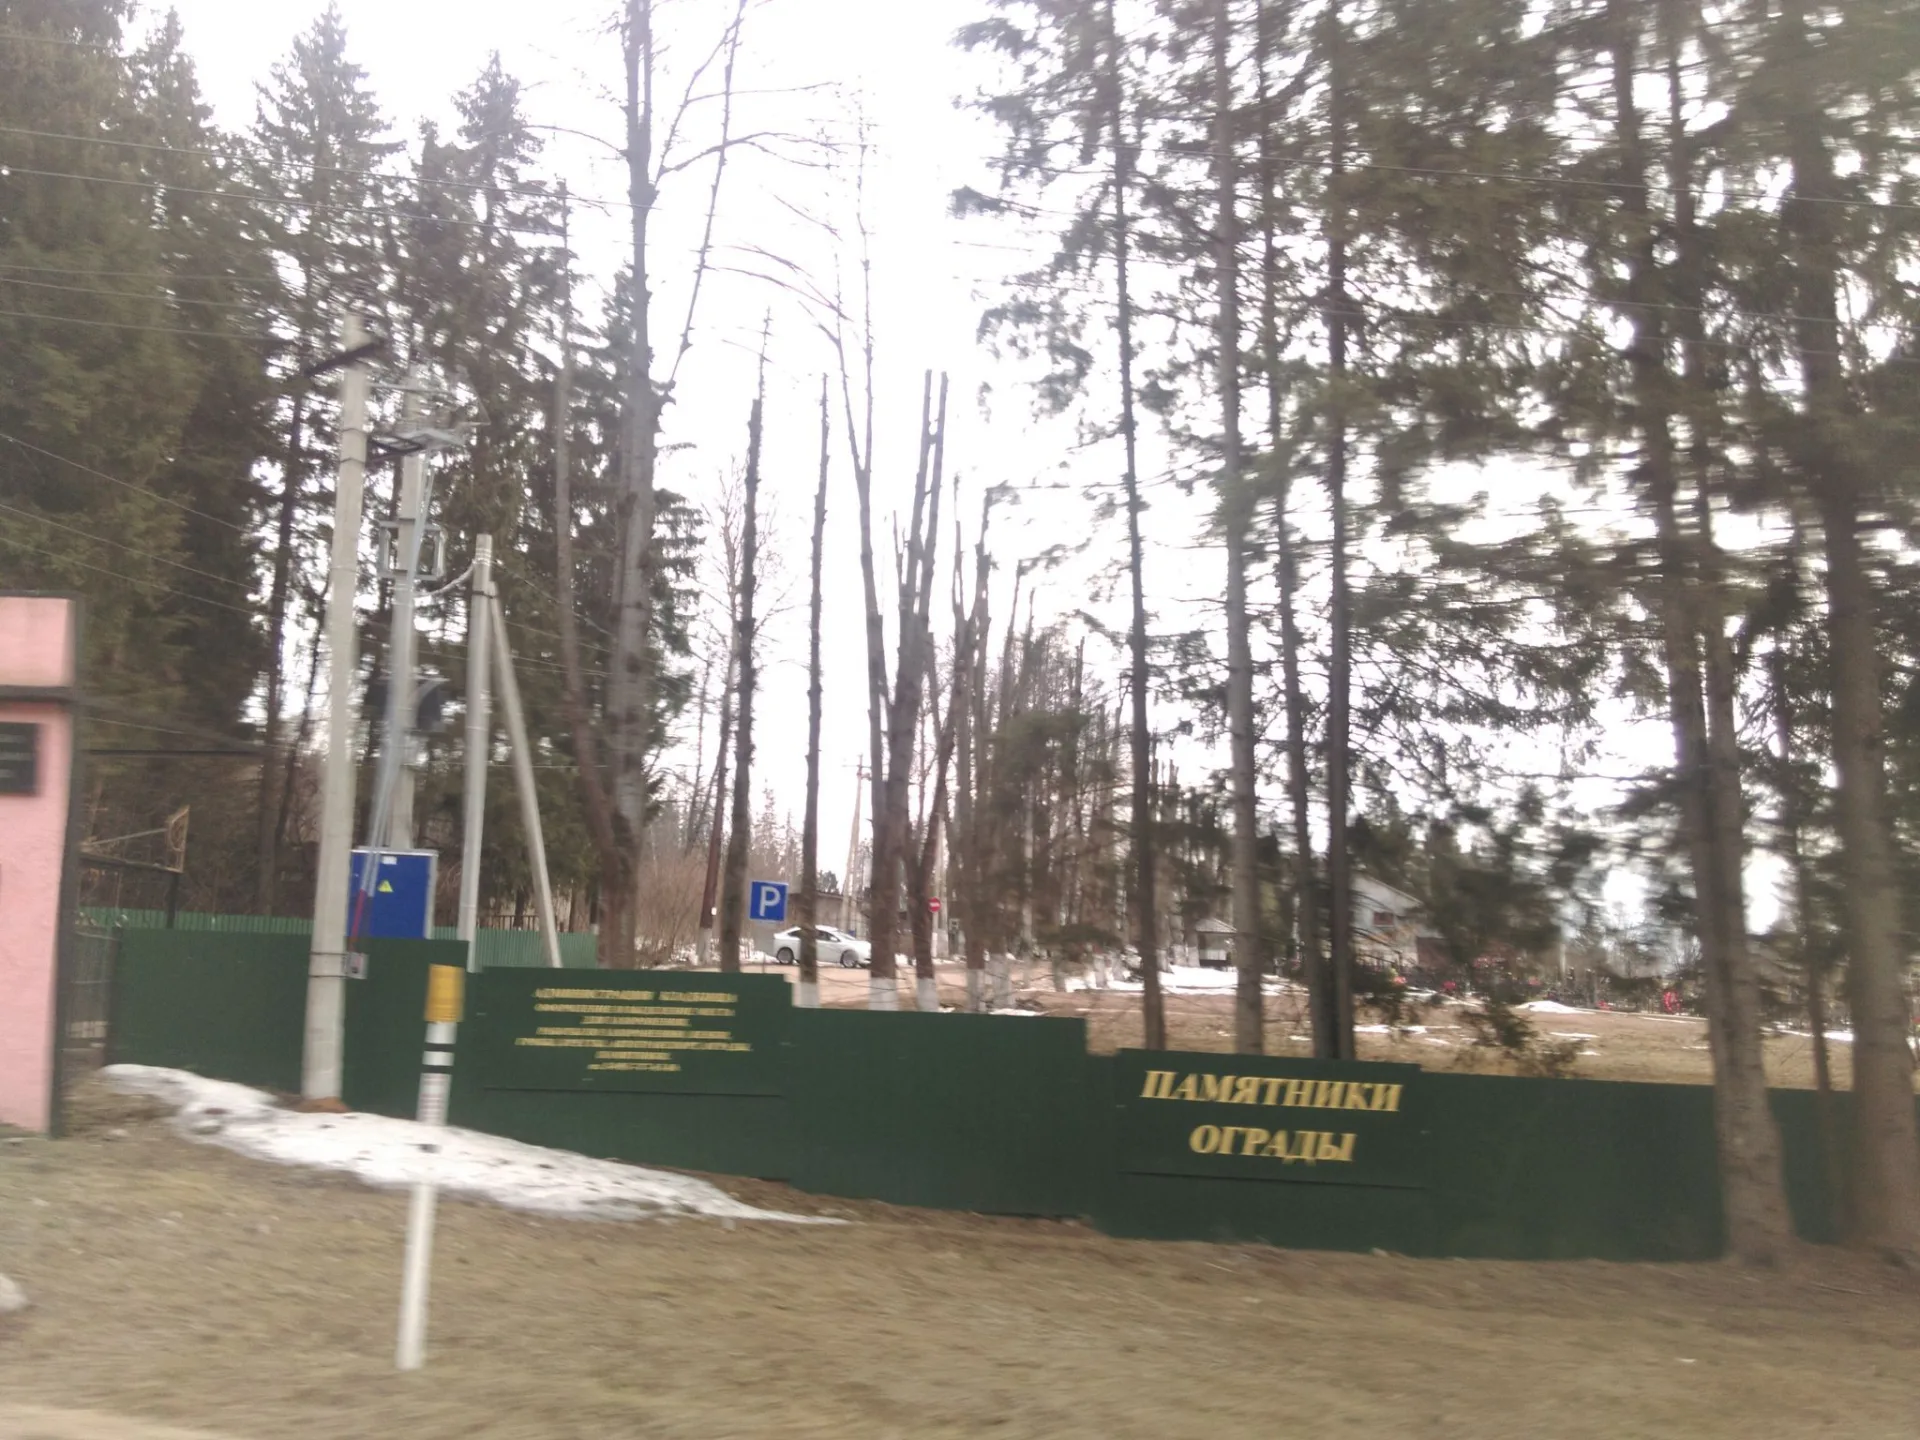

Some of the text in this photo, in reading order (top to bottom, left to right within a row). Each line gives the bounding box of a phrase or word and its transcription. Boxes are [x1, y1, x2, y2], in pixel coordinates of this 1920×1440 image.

[759, 886, 780, 916] P
[1140, 1070, 1403, 1111] ПАМЯТНИКИ
[1189, 1124, 1357, 1165] ОГРАДЫ
